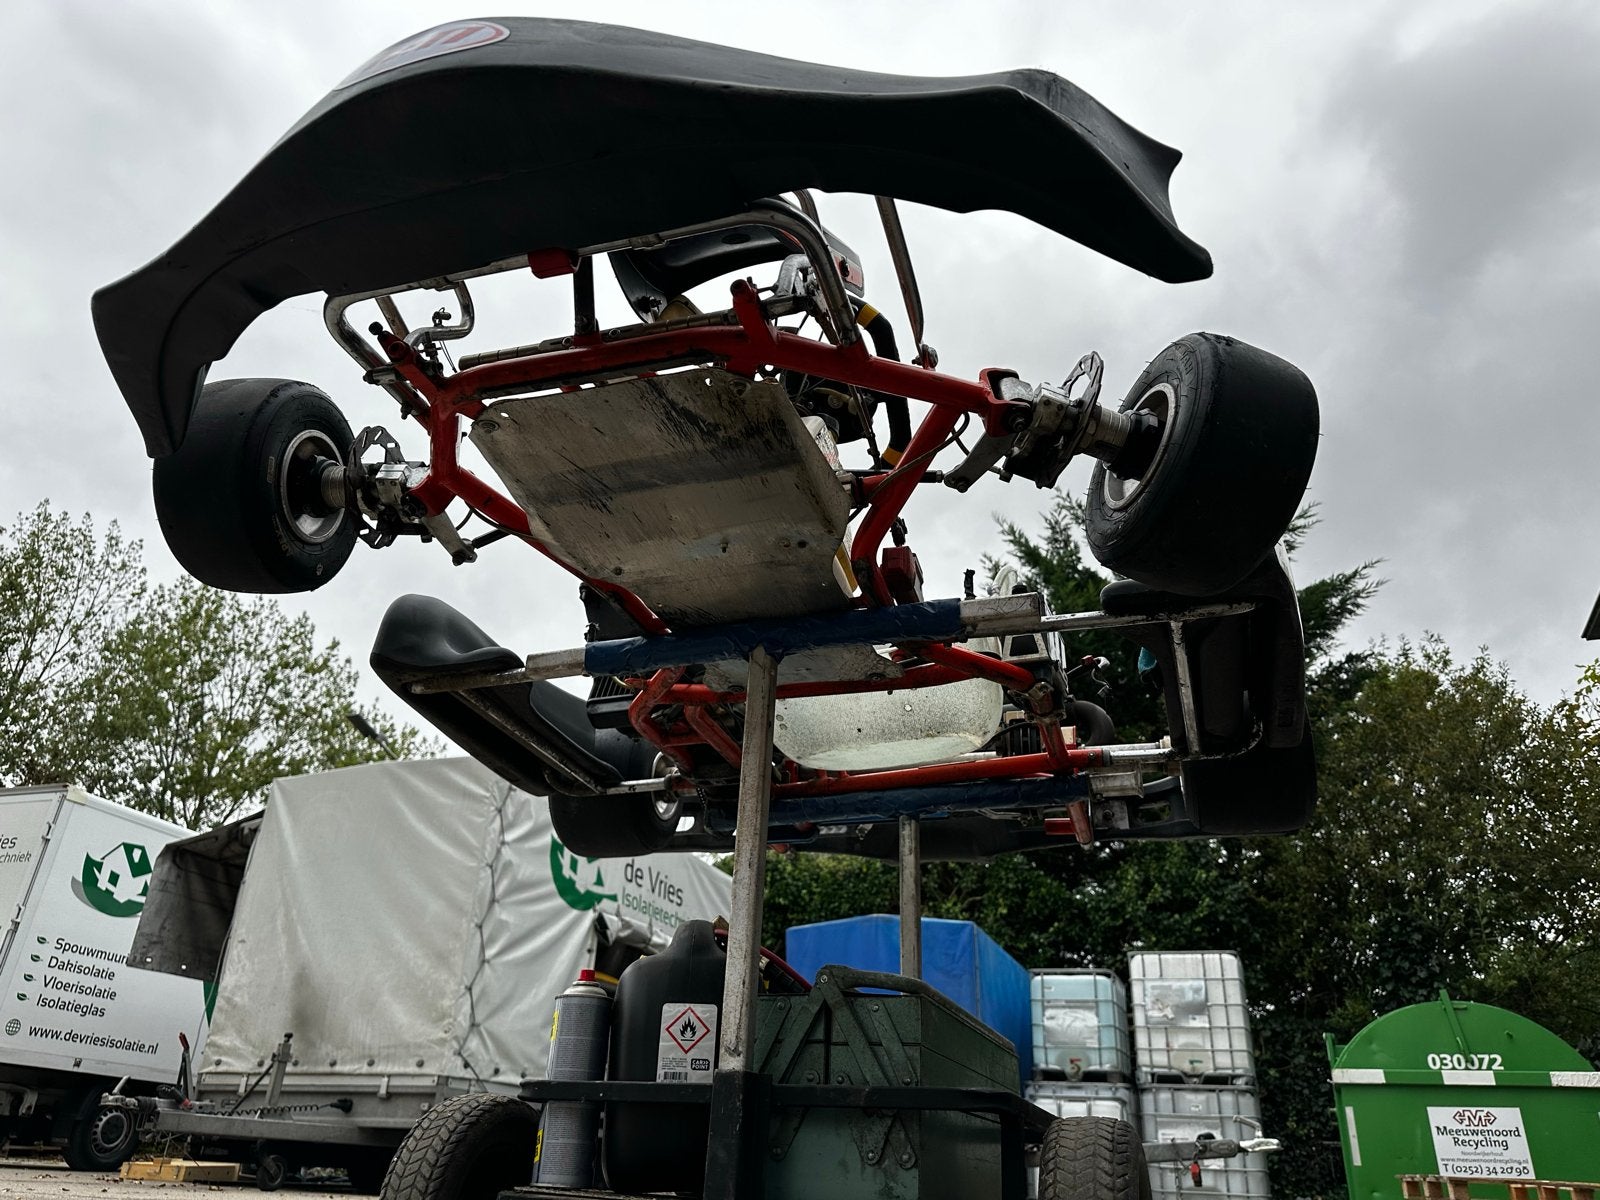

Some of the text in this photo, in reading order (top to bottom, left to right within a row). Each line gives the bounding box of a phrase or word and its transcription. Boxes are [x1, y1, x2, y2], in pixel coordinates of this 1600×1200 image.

[624, 858, 684, 907] de Vries
[621, 886, 686, 928] Isolatietech
[47, 955, 116, 981] Dakisolatie
[43, 974, 117, 1001] Vloerisolatie
[36, 993, 107, 1018] Isolatieglas
[28, 1025, 159, 1056] www.devriesisolatie.nl
[1427, 1053, 1504, 1070] 030072
[1435, 1126, 1522, 1138] Meeuwenoord
[1452, 1137, 1509, 1151] Recycling
[1442, 1164, 1449, 1172] T
[1451, 1164, 1483, 1175] (0252)
[1486, 1166, 1498, 1175] 34
